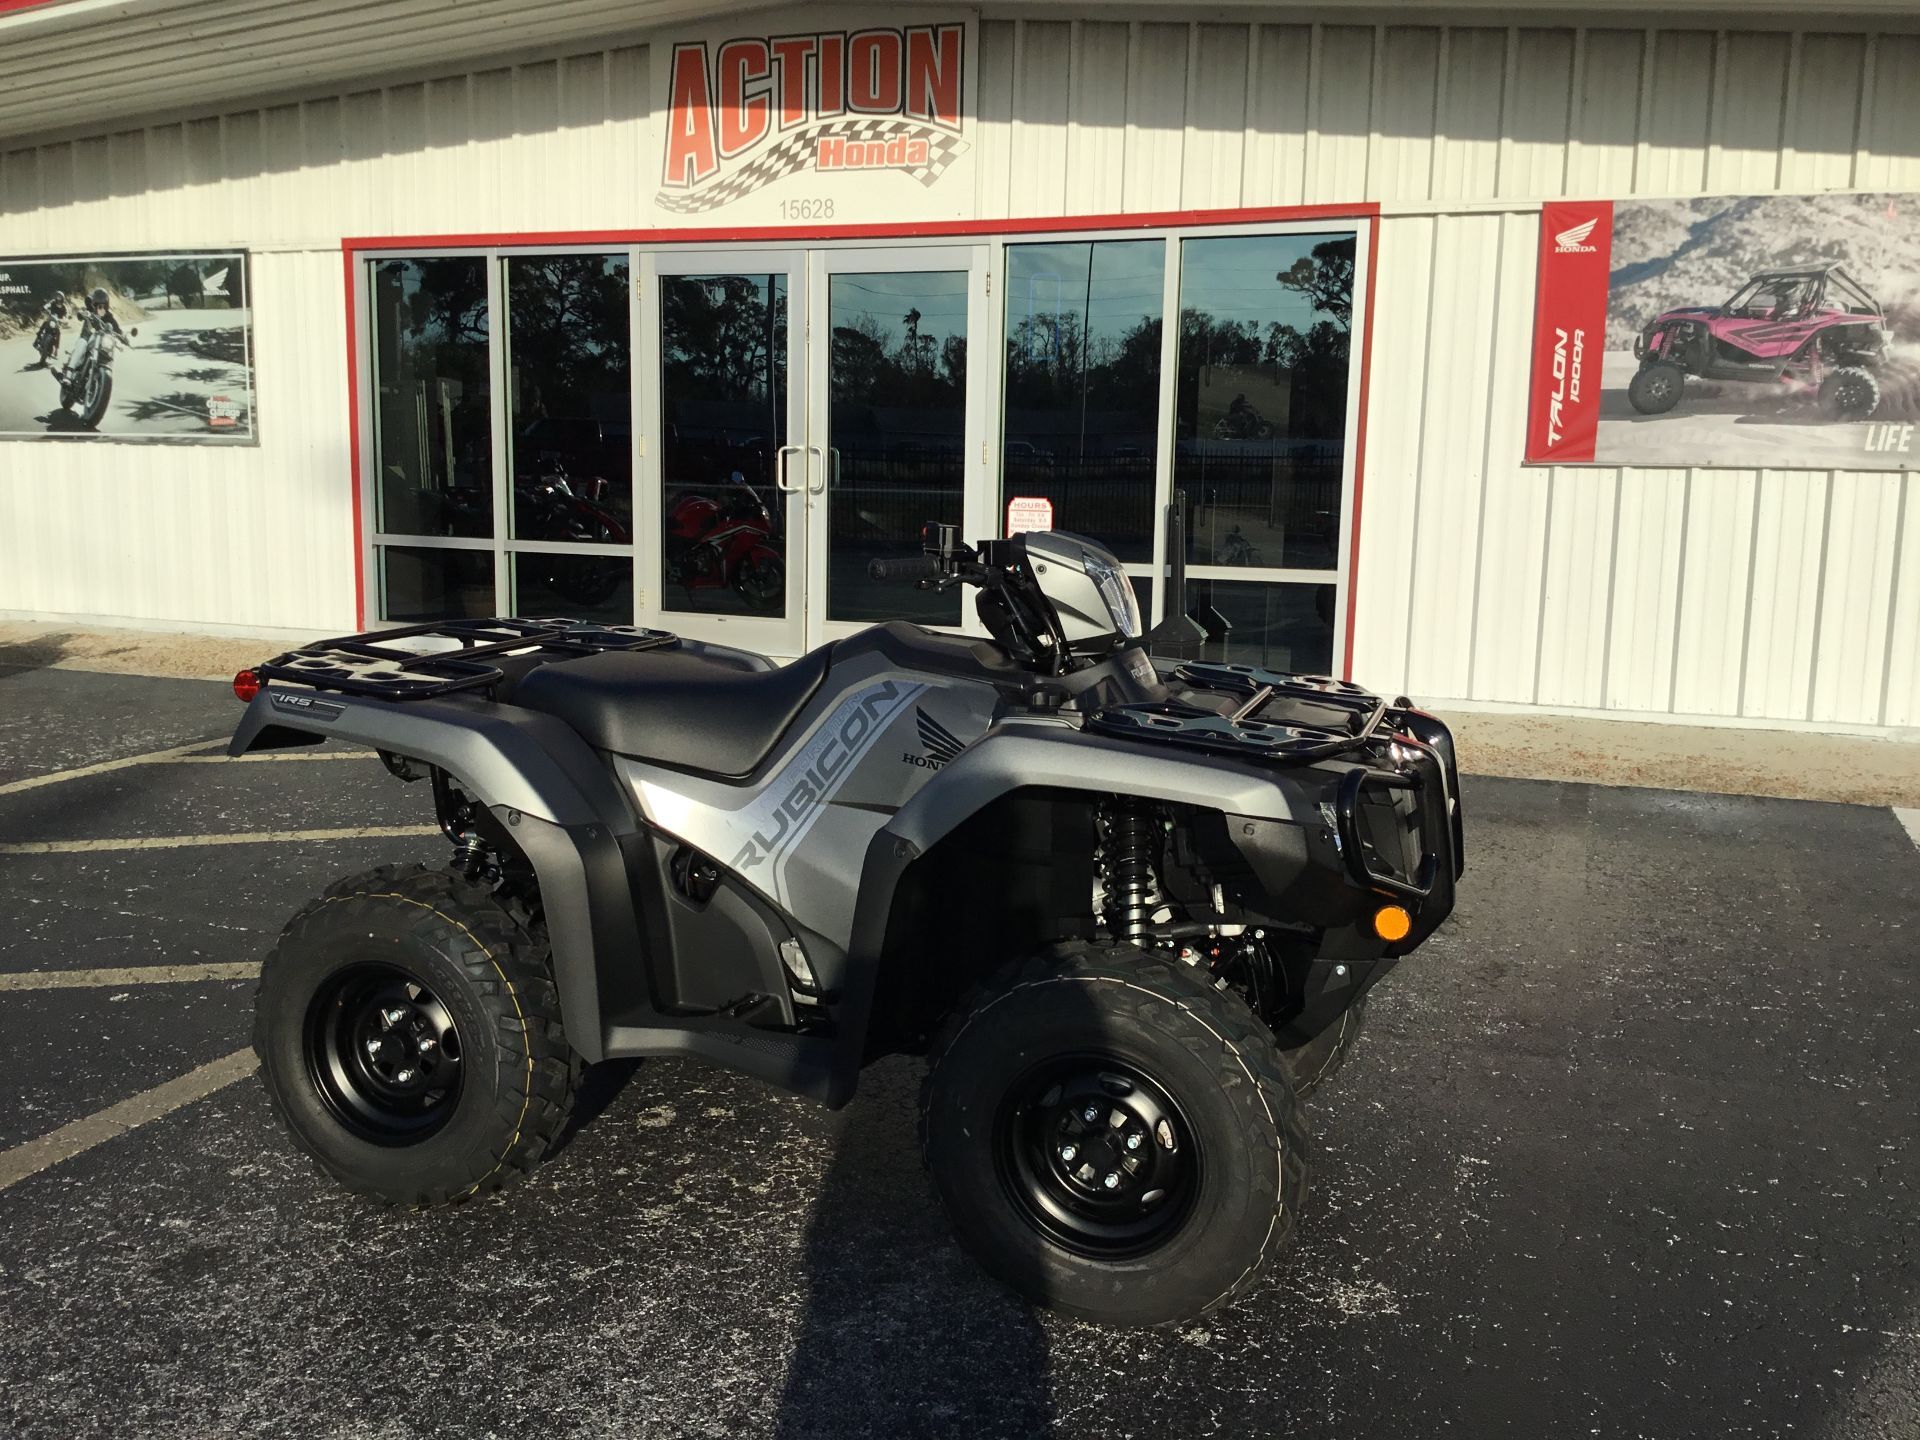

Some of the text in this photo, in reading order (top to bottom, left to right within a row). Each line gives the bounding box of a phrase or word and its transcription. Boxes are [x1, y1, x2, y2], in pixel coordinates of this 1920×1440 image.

[662, 22, 965, 188] ACTION
[816, 134, 929, 170] Honda
[779, 198, 835, 220] 15628
[1554, 245, 1597, 253] HONDA
[1569, 328, 1585, 404] 1000R
[1547, 327, 1568, 447] TALON
[1864, 425, 1915, 452] LIFE
[278, 694, 313, 707] IRS
[729, 680, 900, 870] RUBICON
[901, 752, 950, 771] HON
